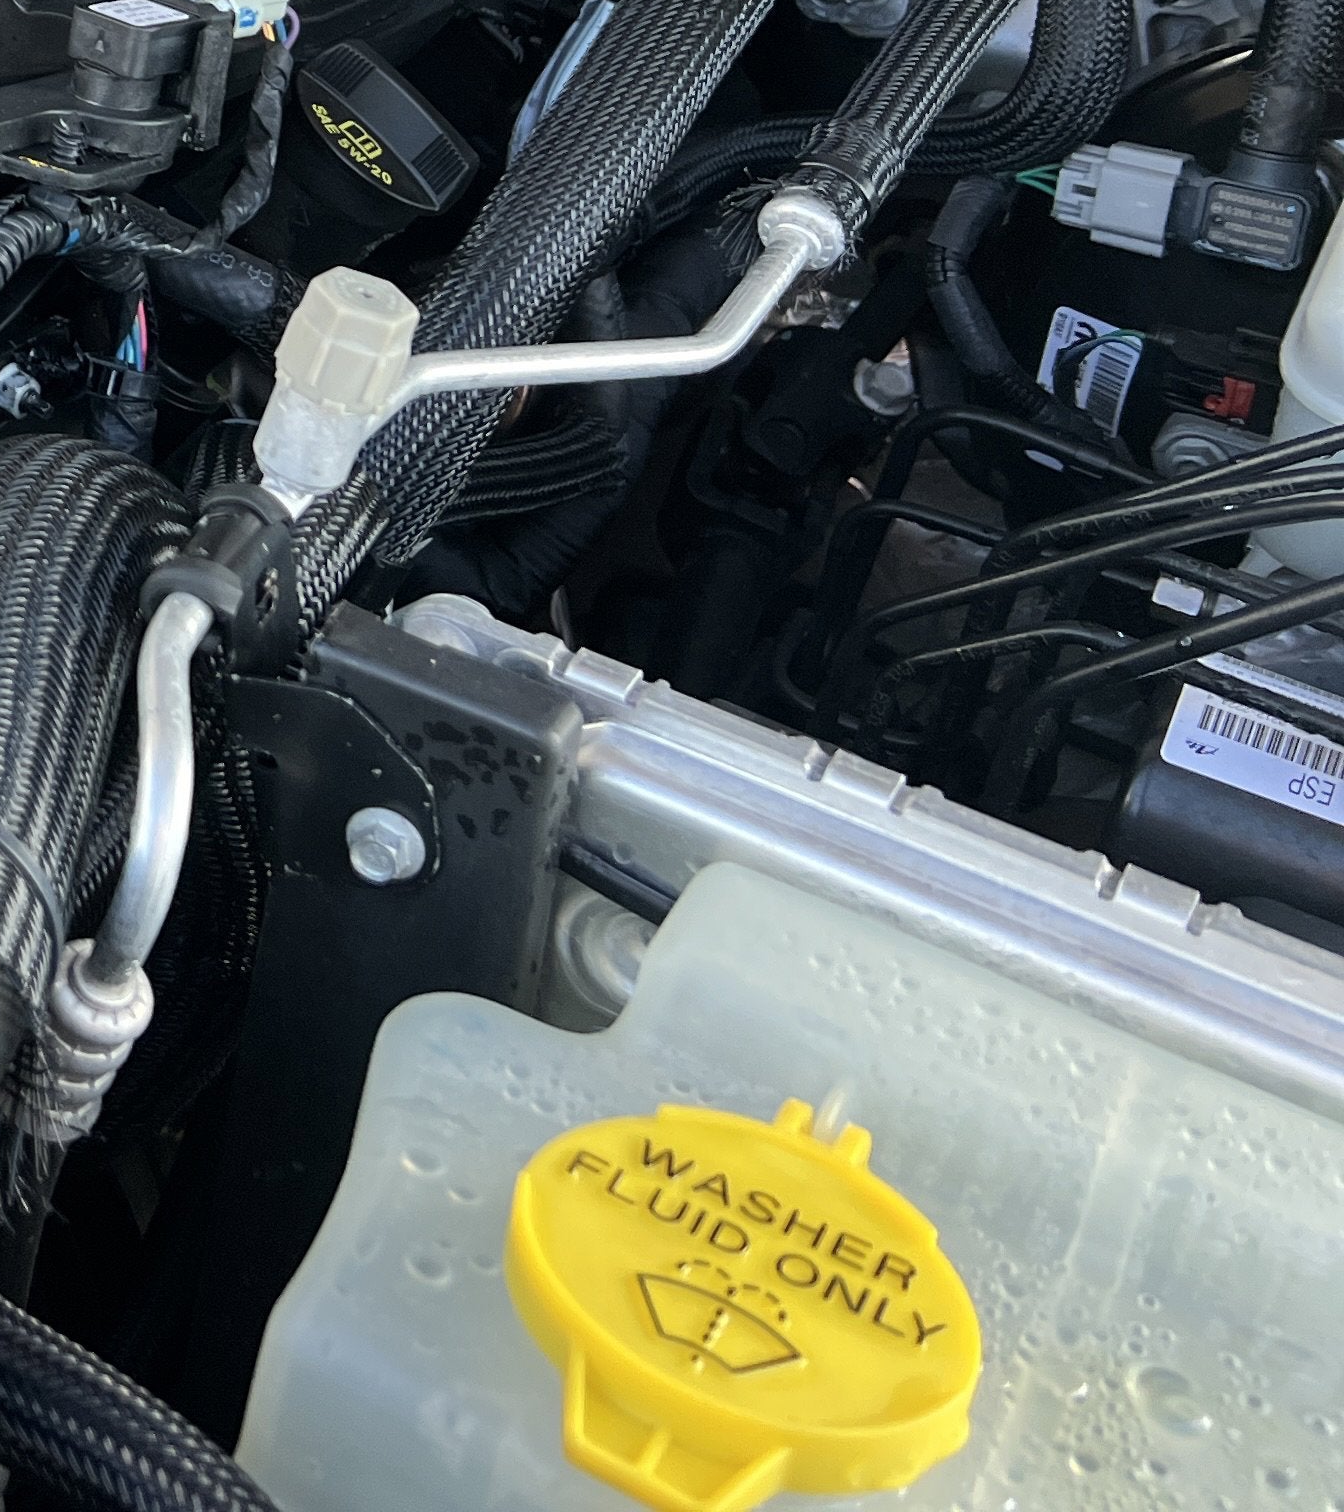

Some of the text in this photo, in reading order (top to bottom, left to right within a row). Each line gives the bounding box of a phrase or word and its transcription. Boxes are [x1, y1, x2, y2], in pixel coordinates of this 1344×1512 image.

[311, 103, 341, 135] SAE
[337, 137, 393, 185] 5W-20
[1287, 773, 1337, 807] ESP
[641, 1137, 918, 1292] WASHER
[566, 1149, 948, 1346] FLUID ONLY
